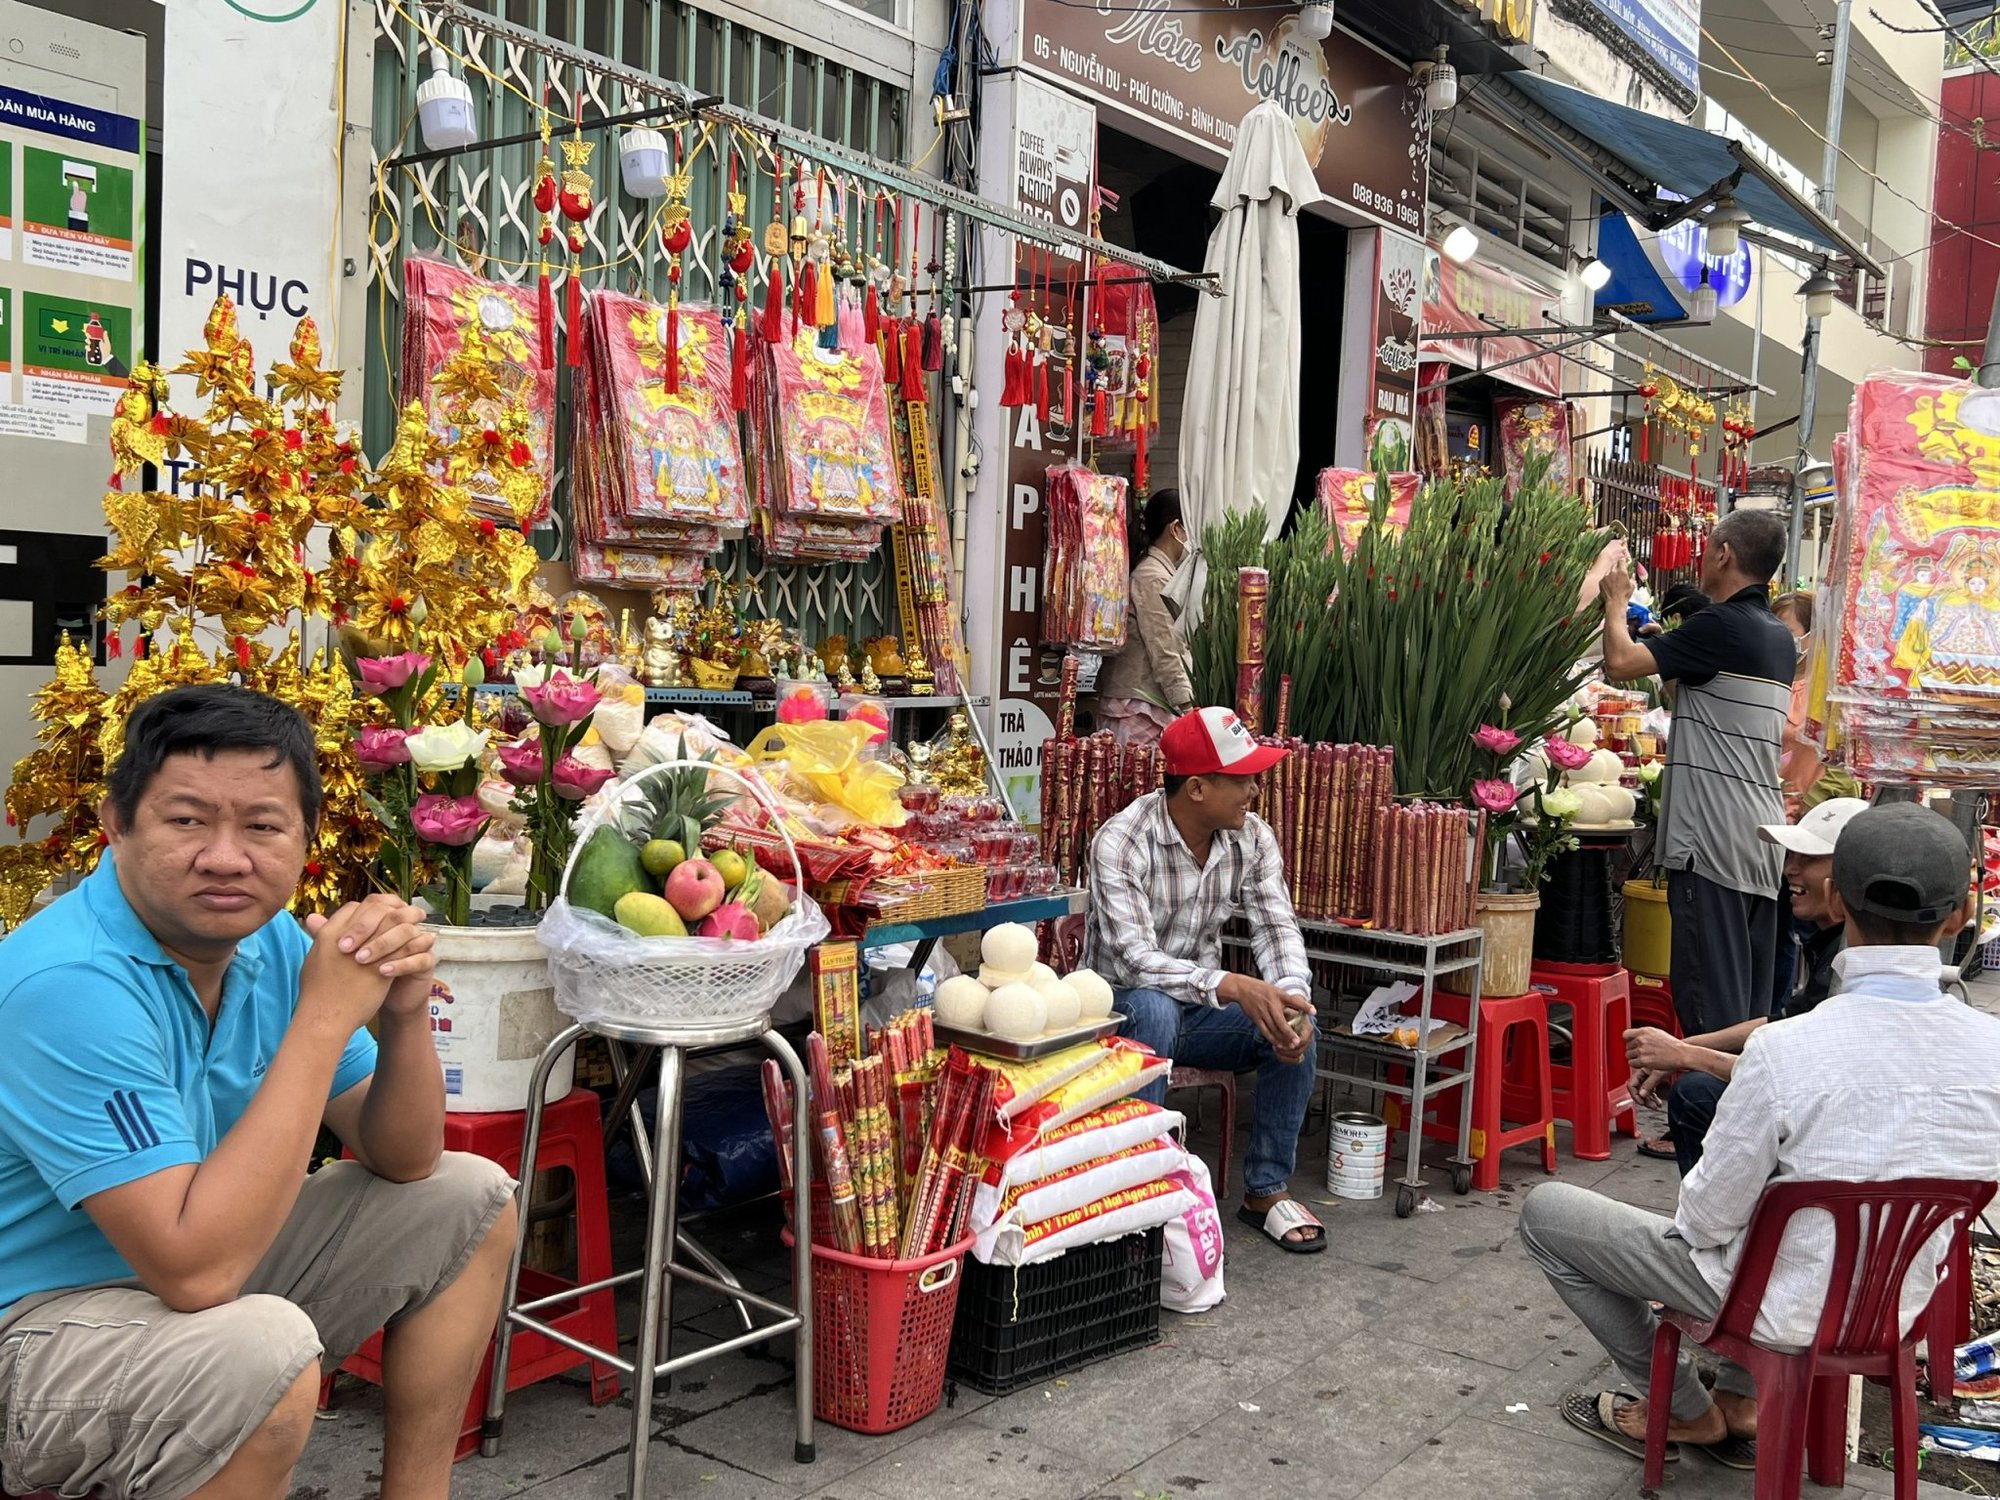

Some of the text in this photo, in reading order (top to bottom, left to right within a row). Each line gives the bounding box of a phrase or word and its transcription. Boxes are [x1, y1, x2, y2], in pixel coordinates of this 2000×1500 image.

[1034, 34, 1050, 60] 05
[1059, 52, 1104, 86] NGUYỄN
[1106, 69, 1121, 92] DU
[1129, 78, 1150, 106] PHÚ
[1191, 106, 1214, 135] BÌNH
[1215, 28, 1351, 125] Coffee
[26, 105, 57, 123] MUA
[59, 113, 97, 133] HÀNG
[1020, 130, 1045, 155] COFFEE
[1019, 150, 1053, 181] ALWAYS
[1018, 174, 1053, 206] A GOOD
[1352, 182, 1419, 227] 088 936 1968
[185, 258, 310, 320] PHỤC
[1377, 388, 1409, 416] RAU MÁ
[1000, 708, 1025, 733] TRÀ
[999, 741, 1033, 769] THẢO
